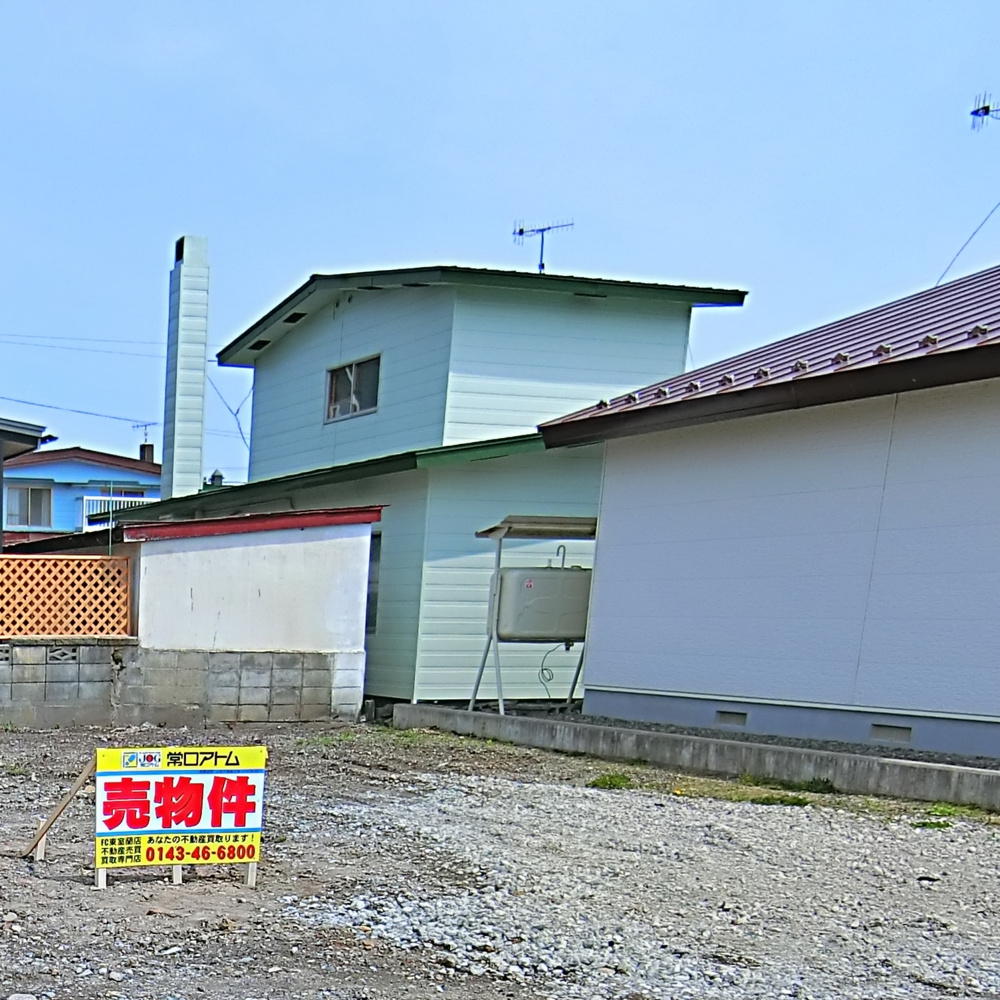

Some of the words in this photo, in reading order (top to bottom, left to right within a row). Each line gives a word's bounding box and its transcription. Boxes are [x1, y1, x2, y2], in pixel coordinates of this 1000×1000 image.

[166, 751, 240, 767] 常口アトム
[102, 776, 256, 831] 売物件
[145, 844, 255, 862] 0143-46-6800
